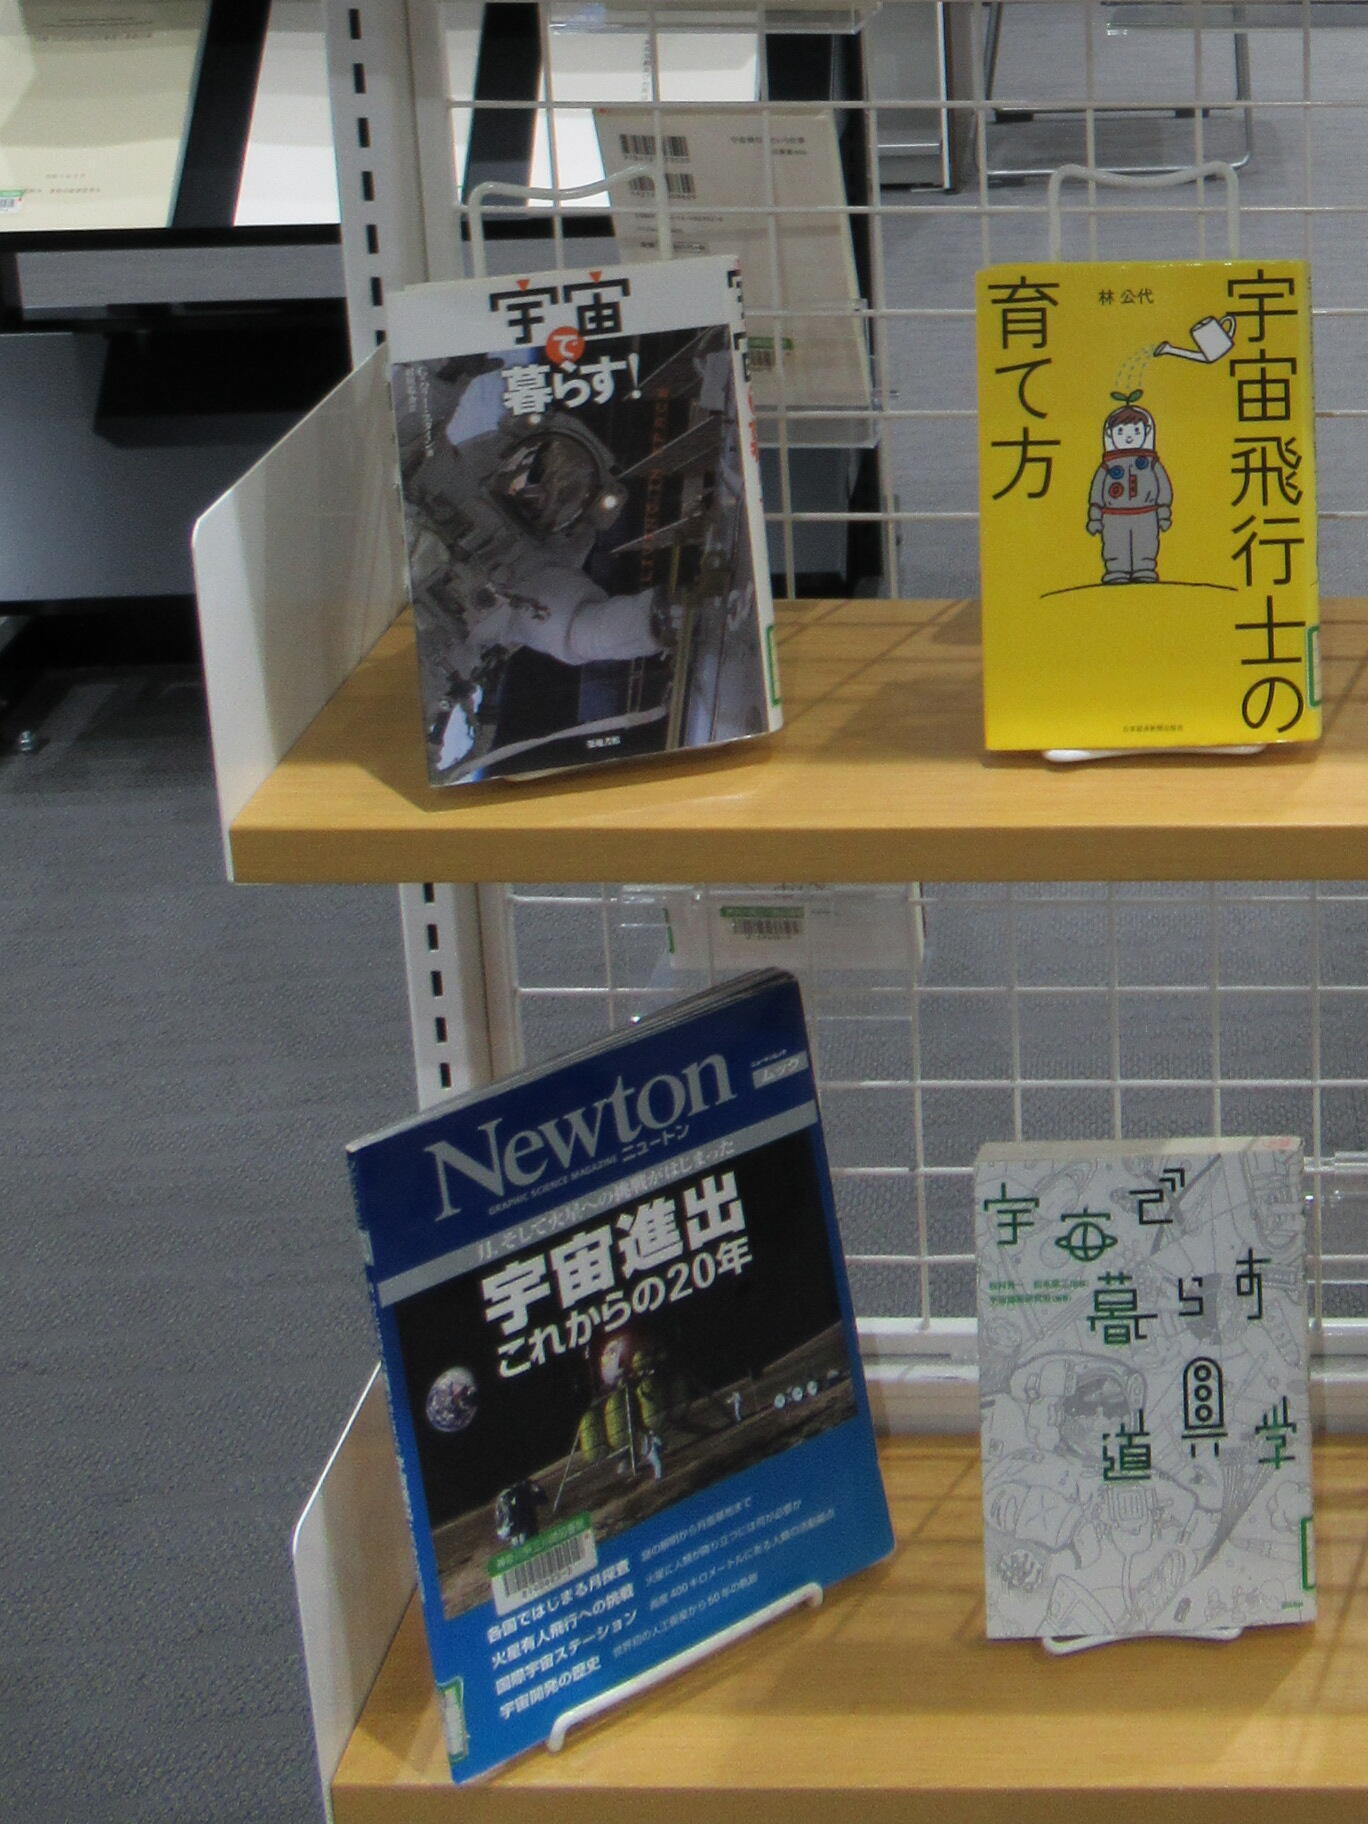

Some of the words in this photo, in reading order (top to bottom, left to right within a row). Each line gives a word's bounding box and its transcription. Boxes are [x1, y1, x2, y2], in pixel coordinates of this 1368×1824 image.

[490, 278, 630, 344] 宇宙
[1099, 289, 1113, 305] 林
[1120, 289, 1155, 305] 公代
[552, 333, 579, 358] で
[502, 353, 642, 416] 暮らす!
[987, 276, 1061, 501] 育て方
[1226, 268, 1307, 734] 宇宙飛行士の
[424, 1053, 738, 1222] Newton
[621, 1124, 691, 1163] ニュートン
[488, 1193, 530, 1216] GRAPHIC
[534, 1179, 569, 1201] SCIENCE
[480, 1170, 747, 1336] 宇宙進出
[497, 1235, 753, 1379] これからの20年
[495, 1608, 638, 1696] 国際宇宙ステーション
[499, 1654, 602, 1721] 宇宙開発の歴史
